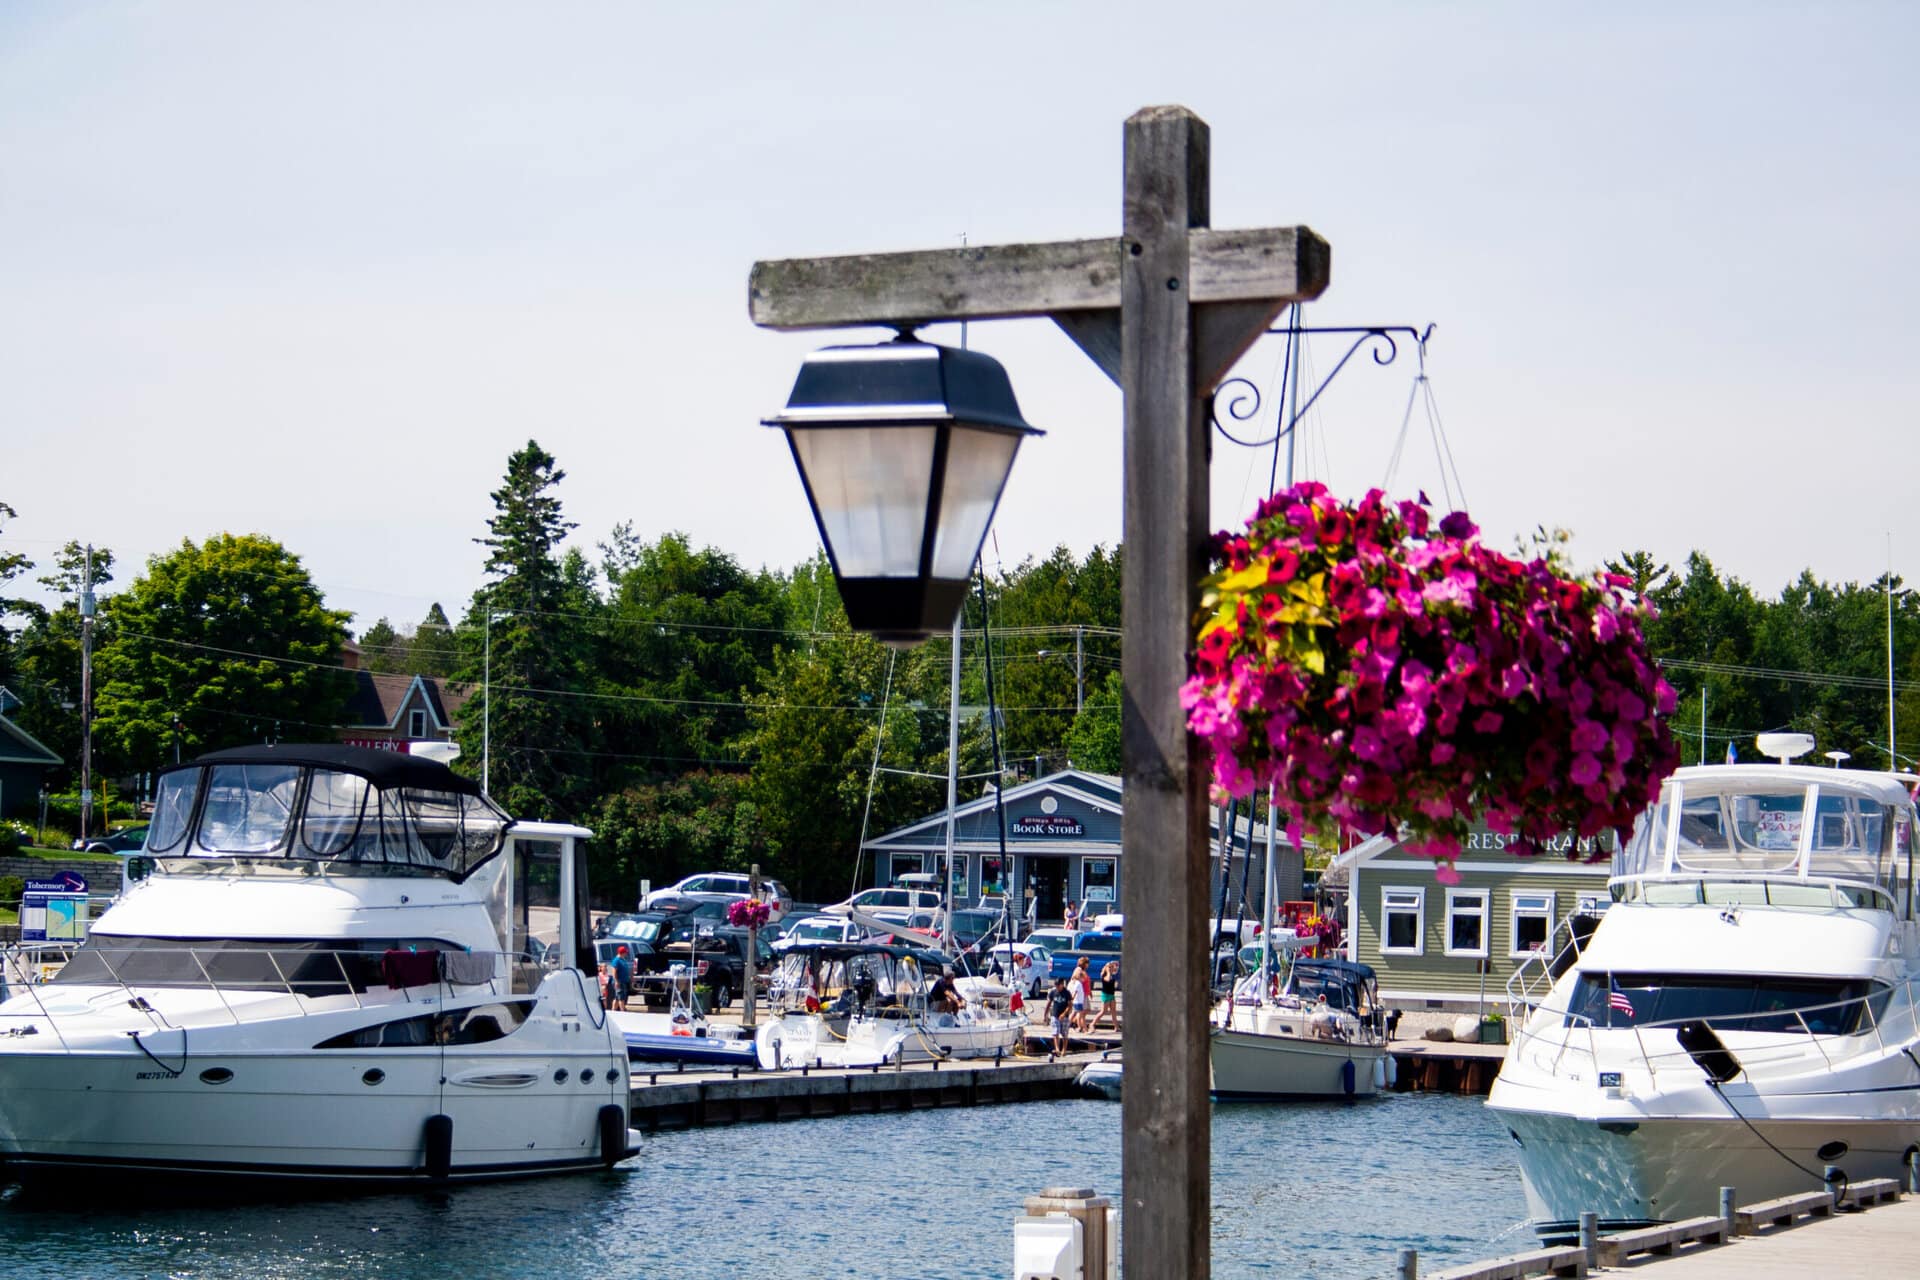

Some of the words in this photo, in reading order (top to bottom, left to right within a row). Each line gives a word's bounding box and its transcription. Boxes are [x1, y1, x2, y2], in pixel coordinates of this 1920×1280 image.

[1013, 823, 1045, 834] BOOK
[1047, 824, 1082, 835] STORE
[26, 881, 66, 892] Tobermory
